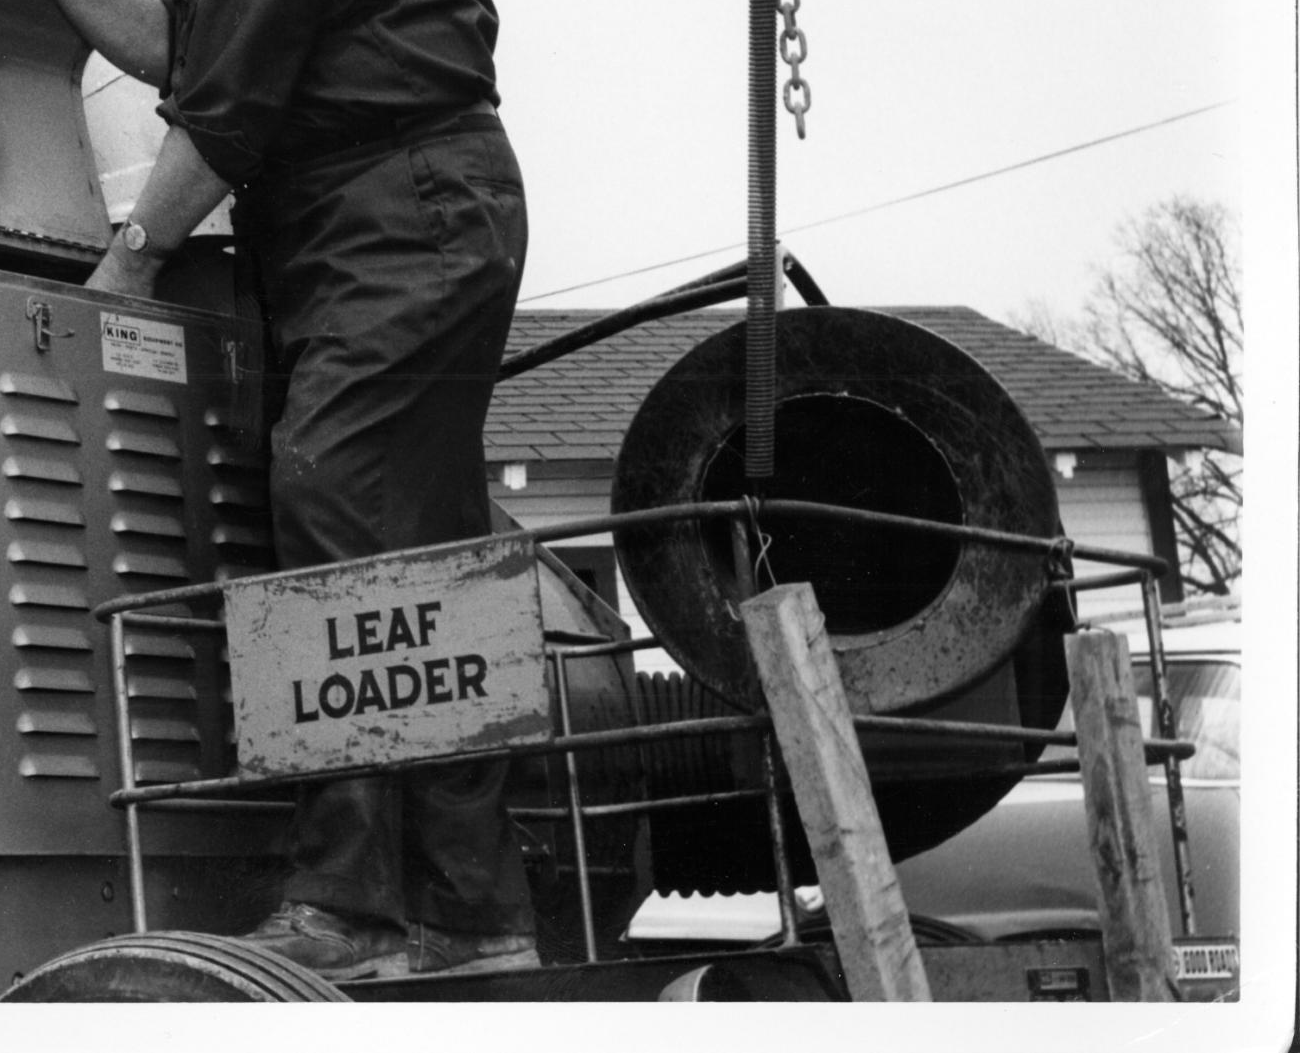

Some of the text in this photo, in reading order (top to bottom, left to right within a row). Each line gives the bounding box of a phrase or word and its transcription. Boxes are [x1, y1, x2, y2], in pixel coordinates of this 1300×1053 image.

[106, 326, 138, 341] KING
[326, 600, 442, 661] LEAF
[292, 653, 489, 725] LOADER
